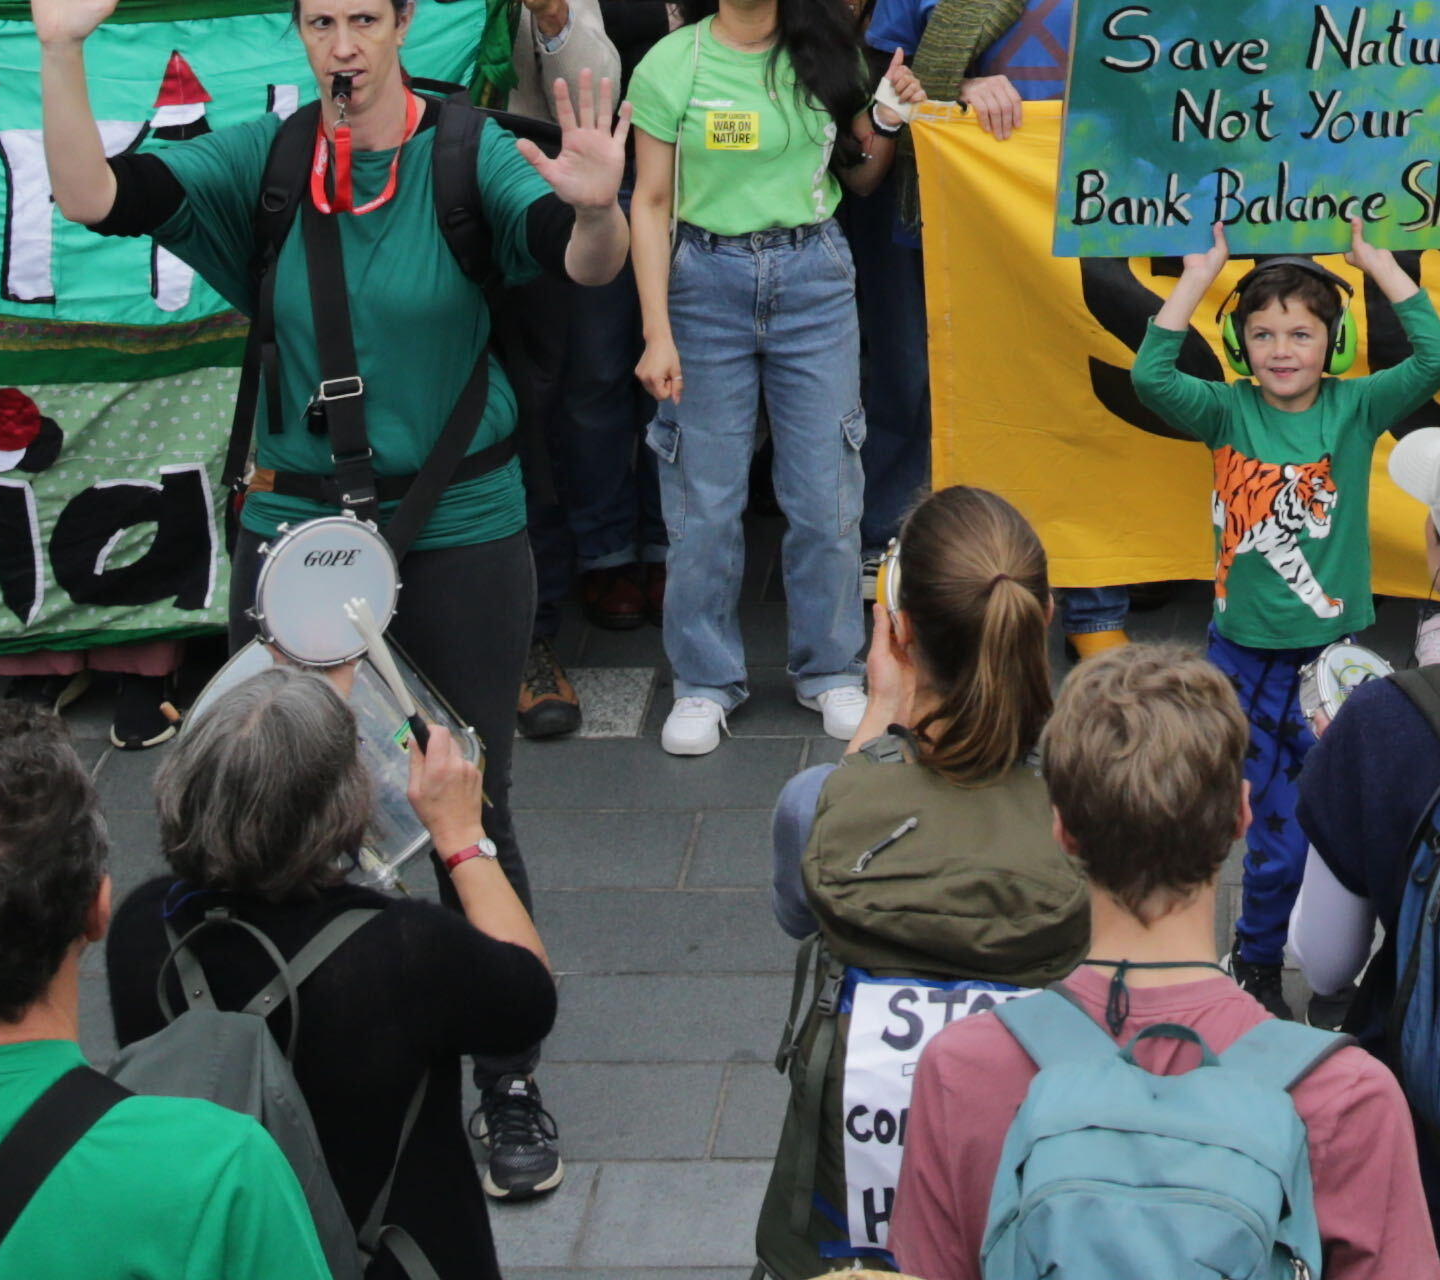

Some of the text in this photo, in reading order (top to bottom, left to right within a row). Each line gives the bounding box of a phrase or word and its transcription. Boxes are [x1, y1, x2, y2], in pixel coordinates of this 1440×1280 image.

[1102, 4, 1268, 73] Save
[1171, 87, 1423, 144] Not Your
[1073, 166, 1192, 228] Bank
[1212, 160, 1388, 224] Balance
[303, 549, 360, 568] GOPE
